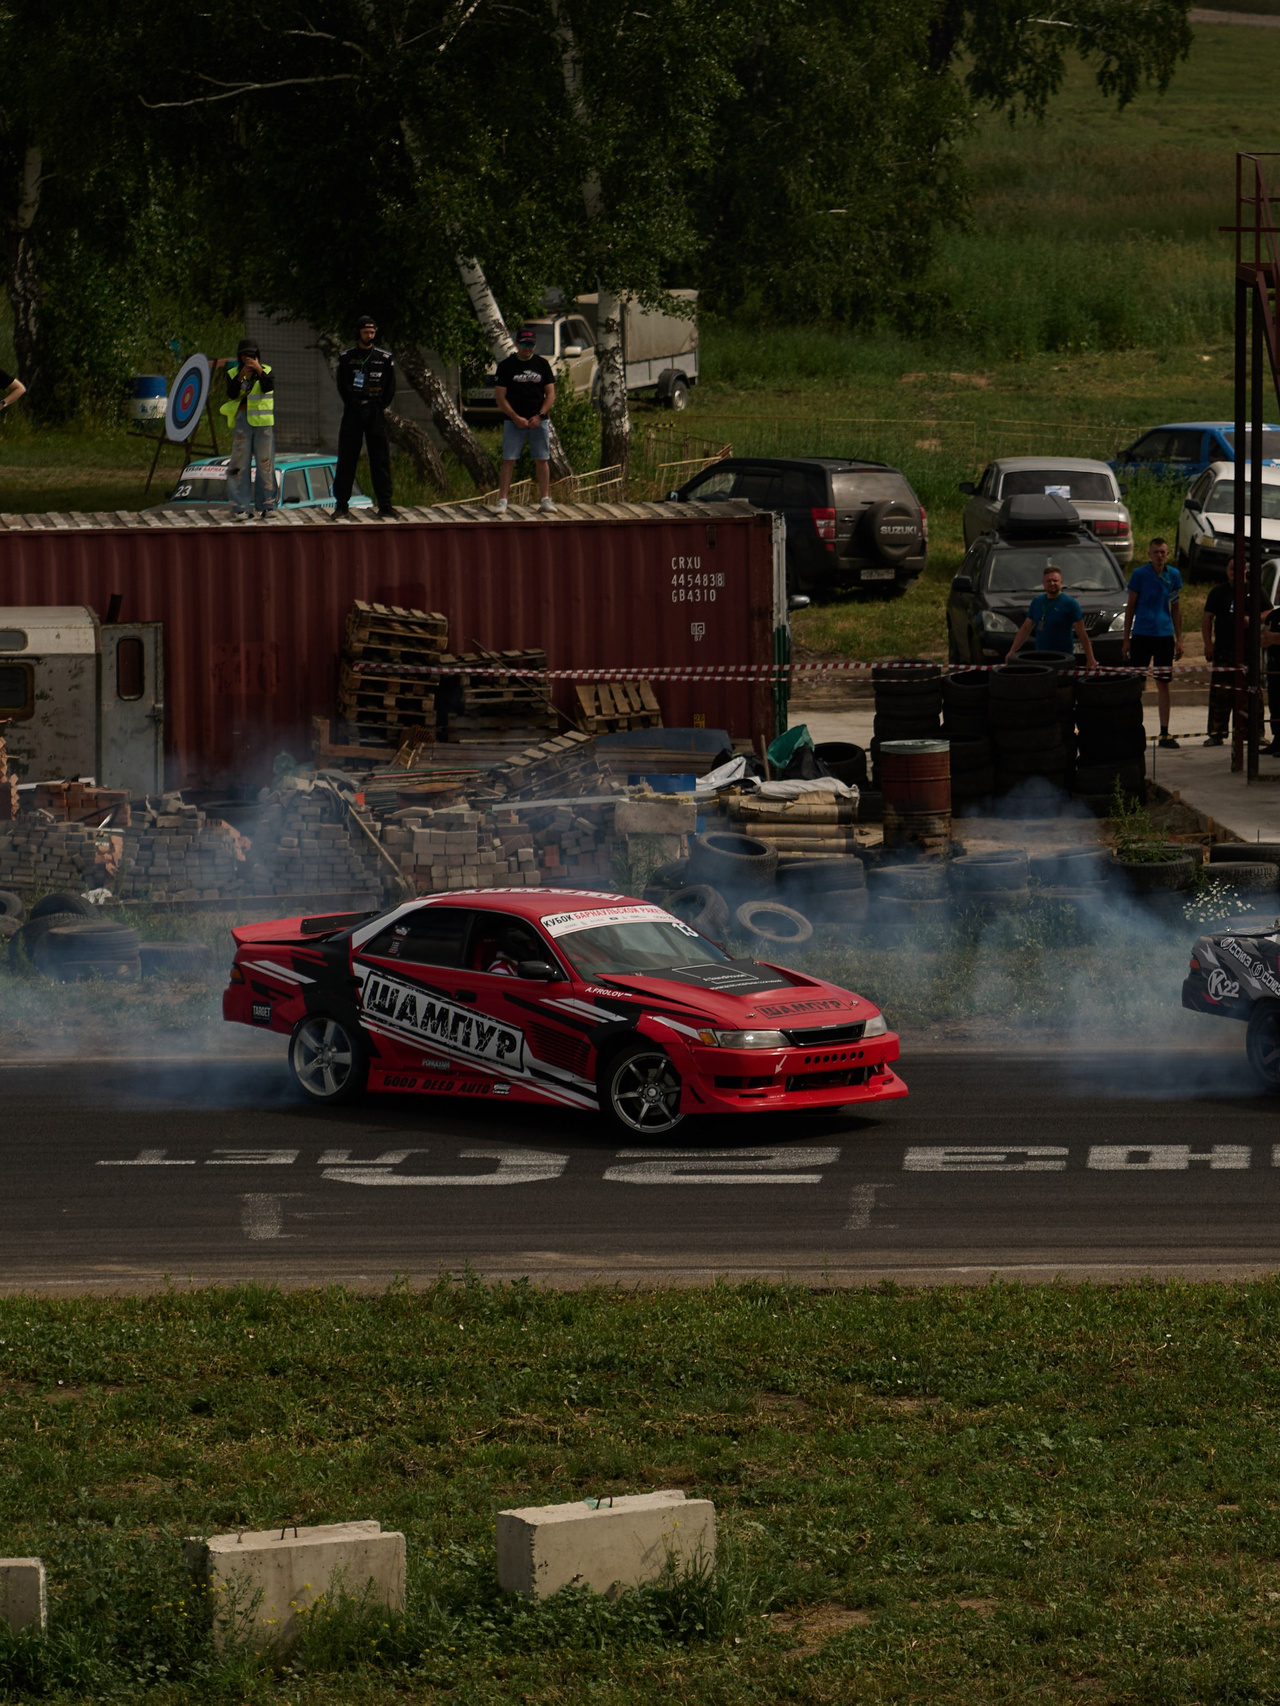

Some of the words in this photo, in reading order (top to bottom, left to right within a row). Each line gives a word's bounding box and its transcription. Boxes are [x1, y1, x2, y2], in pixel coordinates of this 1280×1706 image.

[175, 485, 193, 497] 23
[880, 526, 917, 534] SUZUKI
[671, 557, 701, 570] CRXU
[671, 573, 725, 587] 4454838
[671, 589, 716, 602] GB4310
[543, 914, 574, 928] КУБОК
[574, 907, 638, 920] БАРНАУЛЬСКОЙ
[672, 922, 699, 938] 13
[1228, 942, 1252, 968] СОЮЗ
[585, 986, 625, 998] A.FROLOV
[253, 1005, 271, 1017] TARGET
[762, 1000, 842, 1017] ШАМПУР
[366, 980, 517, 1059] ШАМПУР
[384, 1075, 417, 1089] GOOD
[422, 1078, 455, 1091] DEED
[456, 1082, 490, 1094] AUTO
